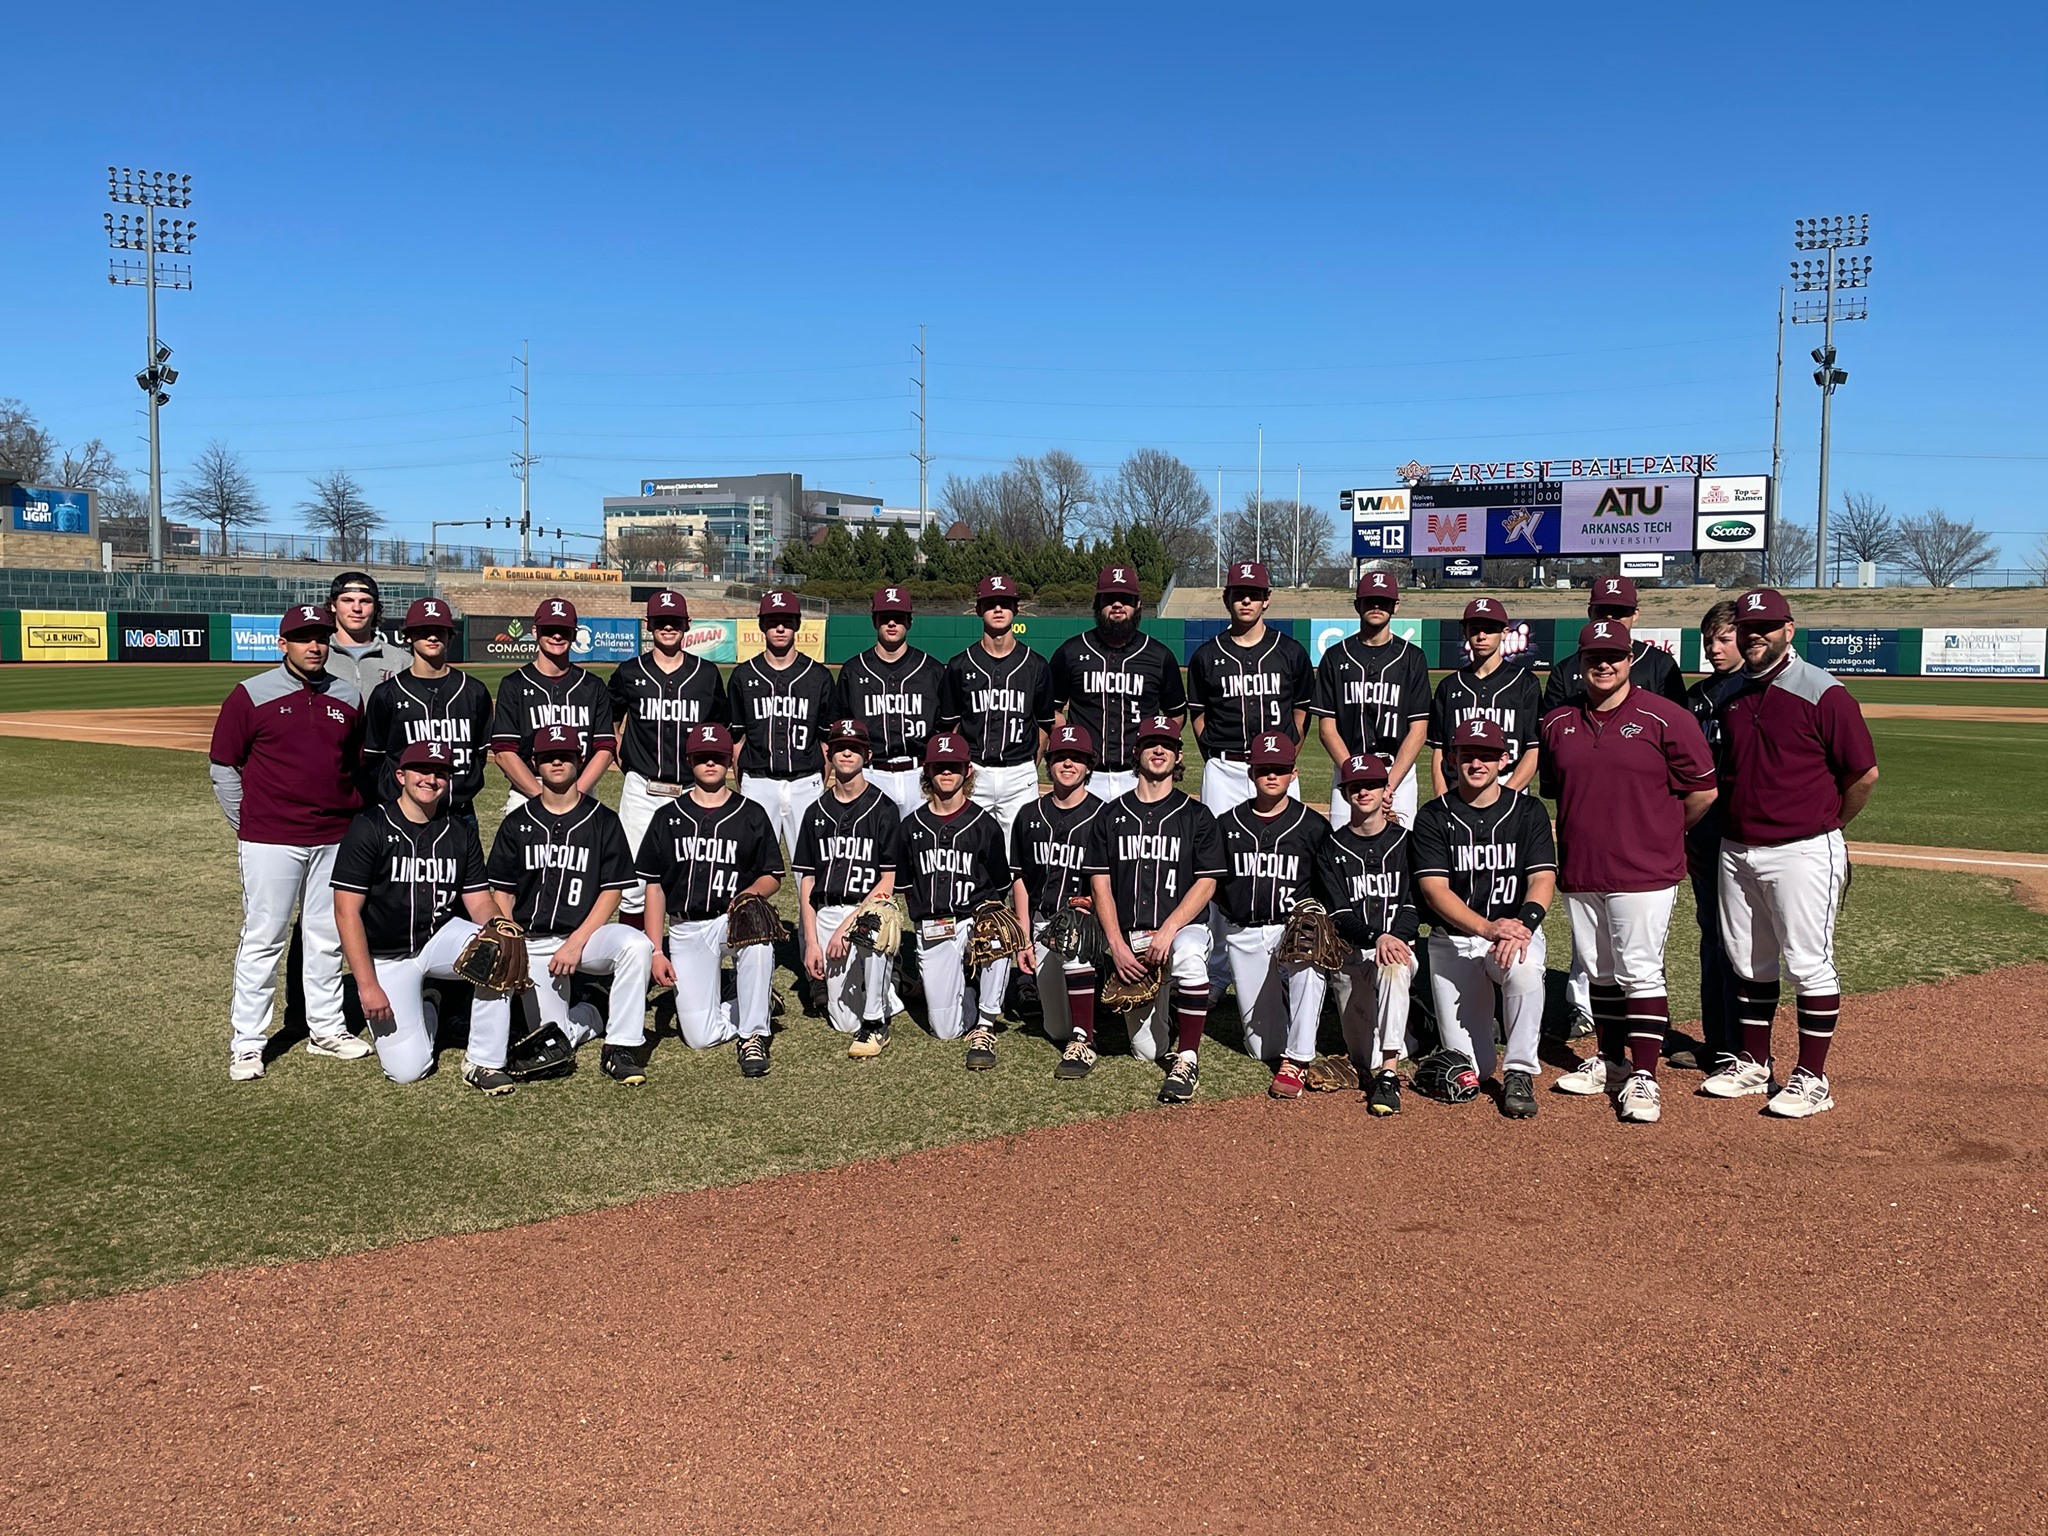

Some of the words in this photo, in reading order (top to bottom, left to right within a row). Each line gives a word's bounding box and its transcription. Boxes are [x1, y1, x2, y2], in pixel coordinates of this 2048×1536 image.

[1397, 465, 1431, 477] ARVEST
[1450, 461, 1554, 484] ARVEST
[1570, 454, 1718, 477] BALLPARK
[26, 501, 49, 513] BUD
[1358, 495, 1405, 511] WM
[1593, 485, 1664, 517] ATU
[23, 510, 52, 522] LIGHT
[1581, 522, 1640, 535] ARKANSAS
[1644, 521, 1672, 533] TECH
[1590, 536, 1661, 546] UNIVERSITY
[1711, 526, 1752, 537] Scotts
[506, 570, 534, 579] GORILLA
[535, 571, 552, 580] GLUE
[574, 572, 601, 581] GORILLA
[602, 572, 619, 582] TAPE
[62, 634, 83, 642] HUNT
[125, 629, 180, 647] Mobil
[594, 631, 635, 640] Arkansas
[795, 632, 818, 643] EES
[1011, 623, 1026, 634] 00
[1821, 634, 1863, 645] ozarks
[1961, 635, 2023, 643] NORTHWEST
[487, 643, 540, 653] CONAGRA
[594, 639, 635, 647] Children's
[1848, 645, 1863, 655] go
[1828, 658, 1876, 666] ozarksgo.net
[1931, 665, 2035, 674] www.northwesthealth.com
[1083, 671, 1144, 696] LINCOLN
[1221, 673, 1281, 698] LINCOLN
[1344, 682, 1401, 707] LINCOLN
[640, 697, 699, 722] LINCOLN
[753, 695, 808, 720] LINCOLN
[865, 693, 922, 716] LINCOLN
[971, 689, 1025, 714] LINCOLN
[1131, 701, 1141, 723] 5
[1270, 701, 1281, 726] 9
[326, 705, 345, 724] LHS
[529, 704, 590, 730] LINCOLN
[1383, 711, 1398, 738] 11
[1455, 707, 1516, 732] LINCOLN
[404, 718, 471, 744] LINCOLN
[792, 725, 808, 750] 13
[904, 718, 927, 739] 30
[1009, 717, 1024, 744] 12
[525, 844, 590, 873] LINCOLN
[674, 836, 737, 864] LINCOLN
[819, 837, 873, 862] LINCOLN
[1118, 835, 1181, 862] LINCOLN
[1450, 843, 1517, 872] LINCOLN
[391, 856, 457, 884] LINCOLN
[919, 848, 973, 876] LINCOLN
[1234, 852, 1299, 881] LINCOLN
[711, 869, 739, 899] 44
[848, 866, 876, 893] 22
[1165, 869, 1177, 898] 4
[1491, 875, 1518, 905] 20
[568, 879, 583, 906] 8
[1278, 885, 1297, 913] 15
